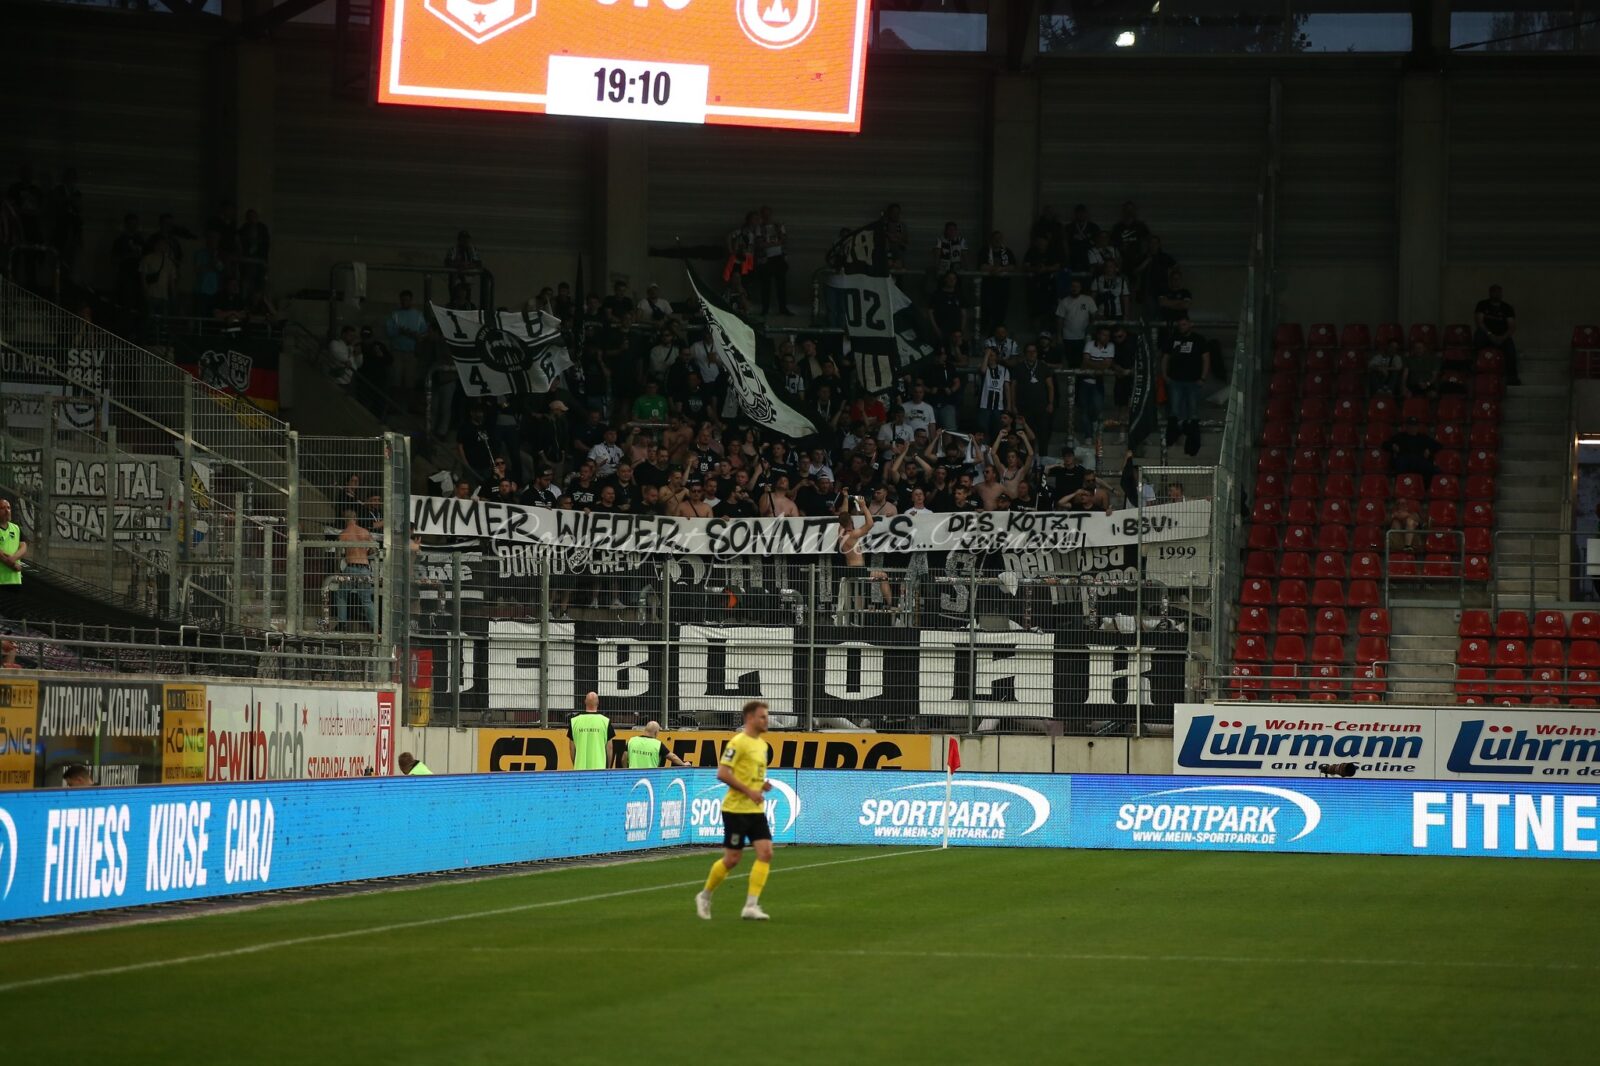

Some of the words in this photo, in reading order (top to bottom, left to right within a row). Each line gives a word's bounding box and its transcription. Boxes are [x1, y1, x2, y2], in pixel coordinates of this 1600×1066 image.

[594, 67, 671, 105] 19:10
[66, 350, 105, 367] SSV
[55, 457, 164, 500] BACTAL
[415, 498, 543, 542] IMMER
[557, 511, 690, 553] WIEDER
[1007, 512, 1091, 532] KOTZT
[1159, 545, 1196, 560] 1999
[39, 685, 161, 738] AUTOHAUS-KOENIG.DE
[1264, 719, 1422, 733] Wohn-Centrum
[166, 717, 205, 753] KÖNIG
[1179, 714, 1424, 770] Lührmann
[1272, 762, 1297, 770] an
[1305, 761, 1330, 770] de
[1542, 767, 1570, 776] an
[859, 799, 1011, 828] SPORTPARK
[1115, 804, 1281, 832] SPORTPARK
[1412, 791, 1599, 852] FITNE
[42, 803, 131, 904] FITNESS
[146, 800, 211, 892] KURSE
[1132, 830, 1276, 845] WWW.MEIN-SPORTPARK.DE
